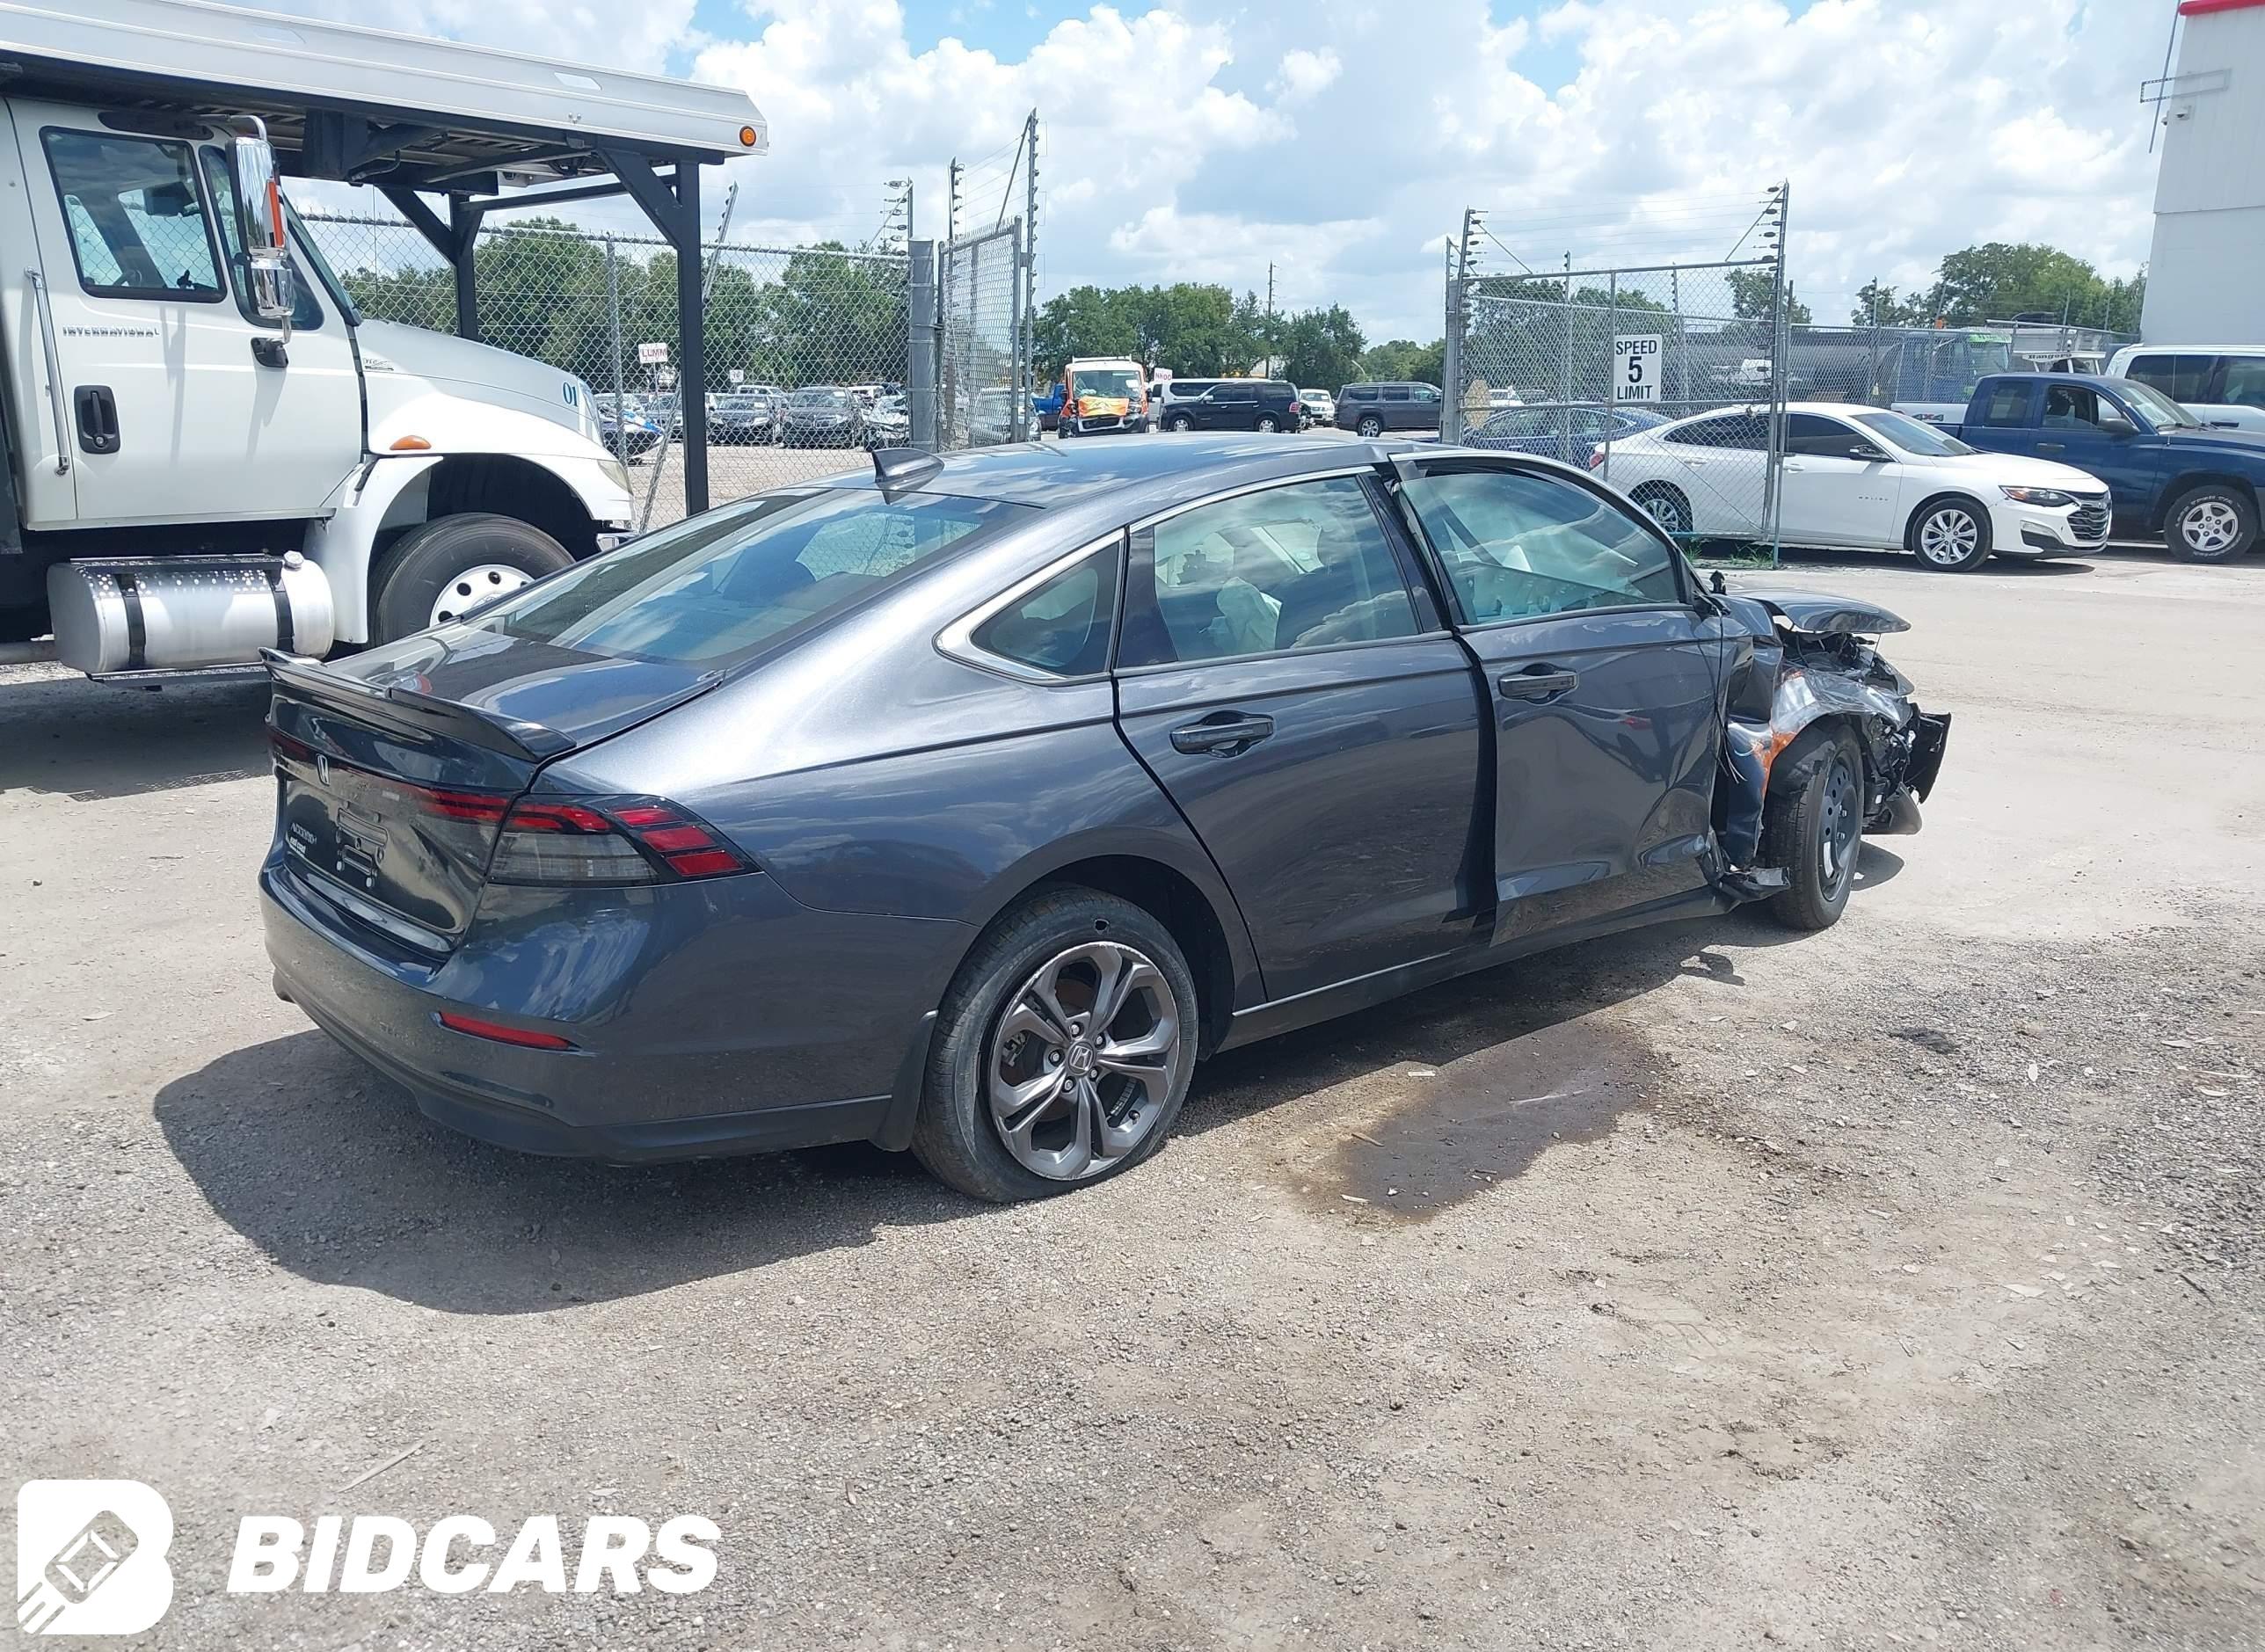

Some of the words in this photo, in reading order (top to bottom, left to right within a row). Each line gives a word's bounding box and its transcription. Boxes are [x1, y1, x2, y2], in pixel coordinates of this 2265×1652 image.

[62, 325, 160, 338] INTERNATIONAL
[1615, 339, 1657, 355] SPEED
[1628, 355, 1643, 383] 5
[563, 382, 578, 407] 01
[1617, 385, 1653, 400] LIMIT
